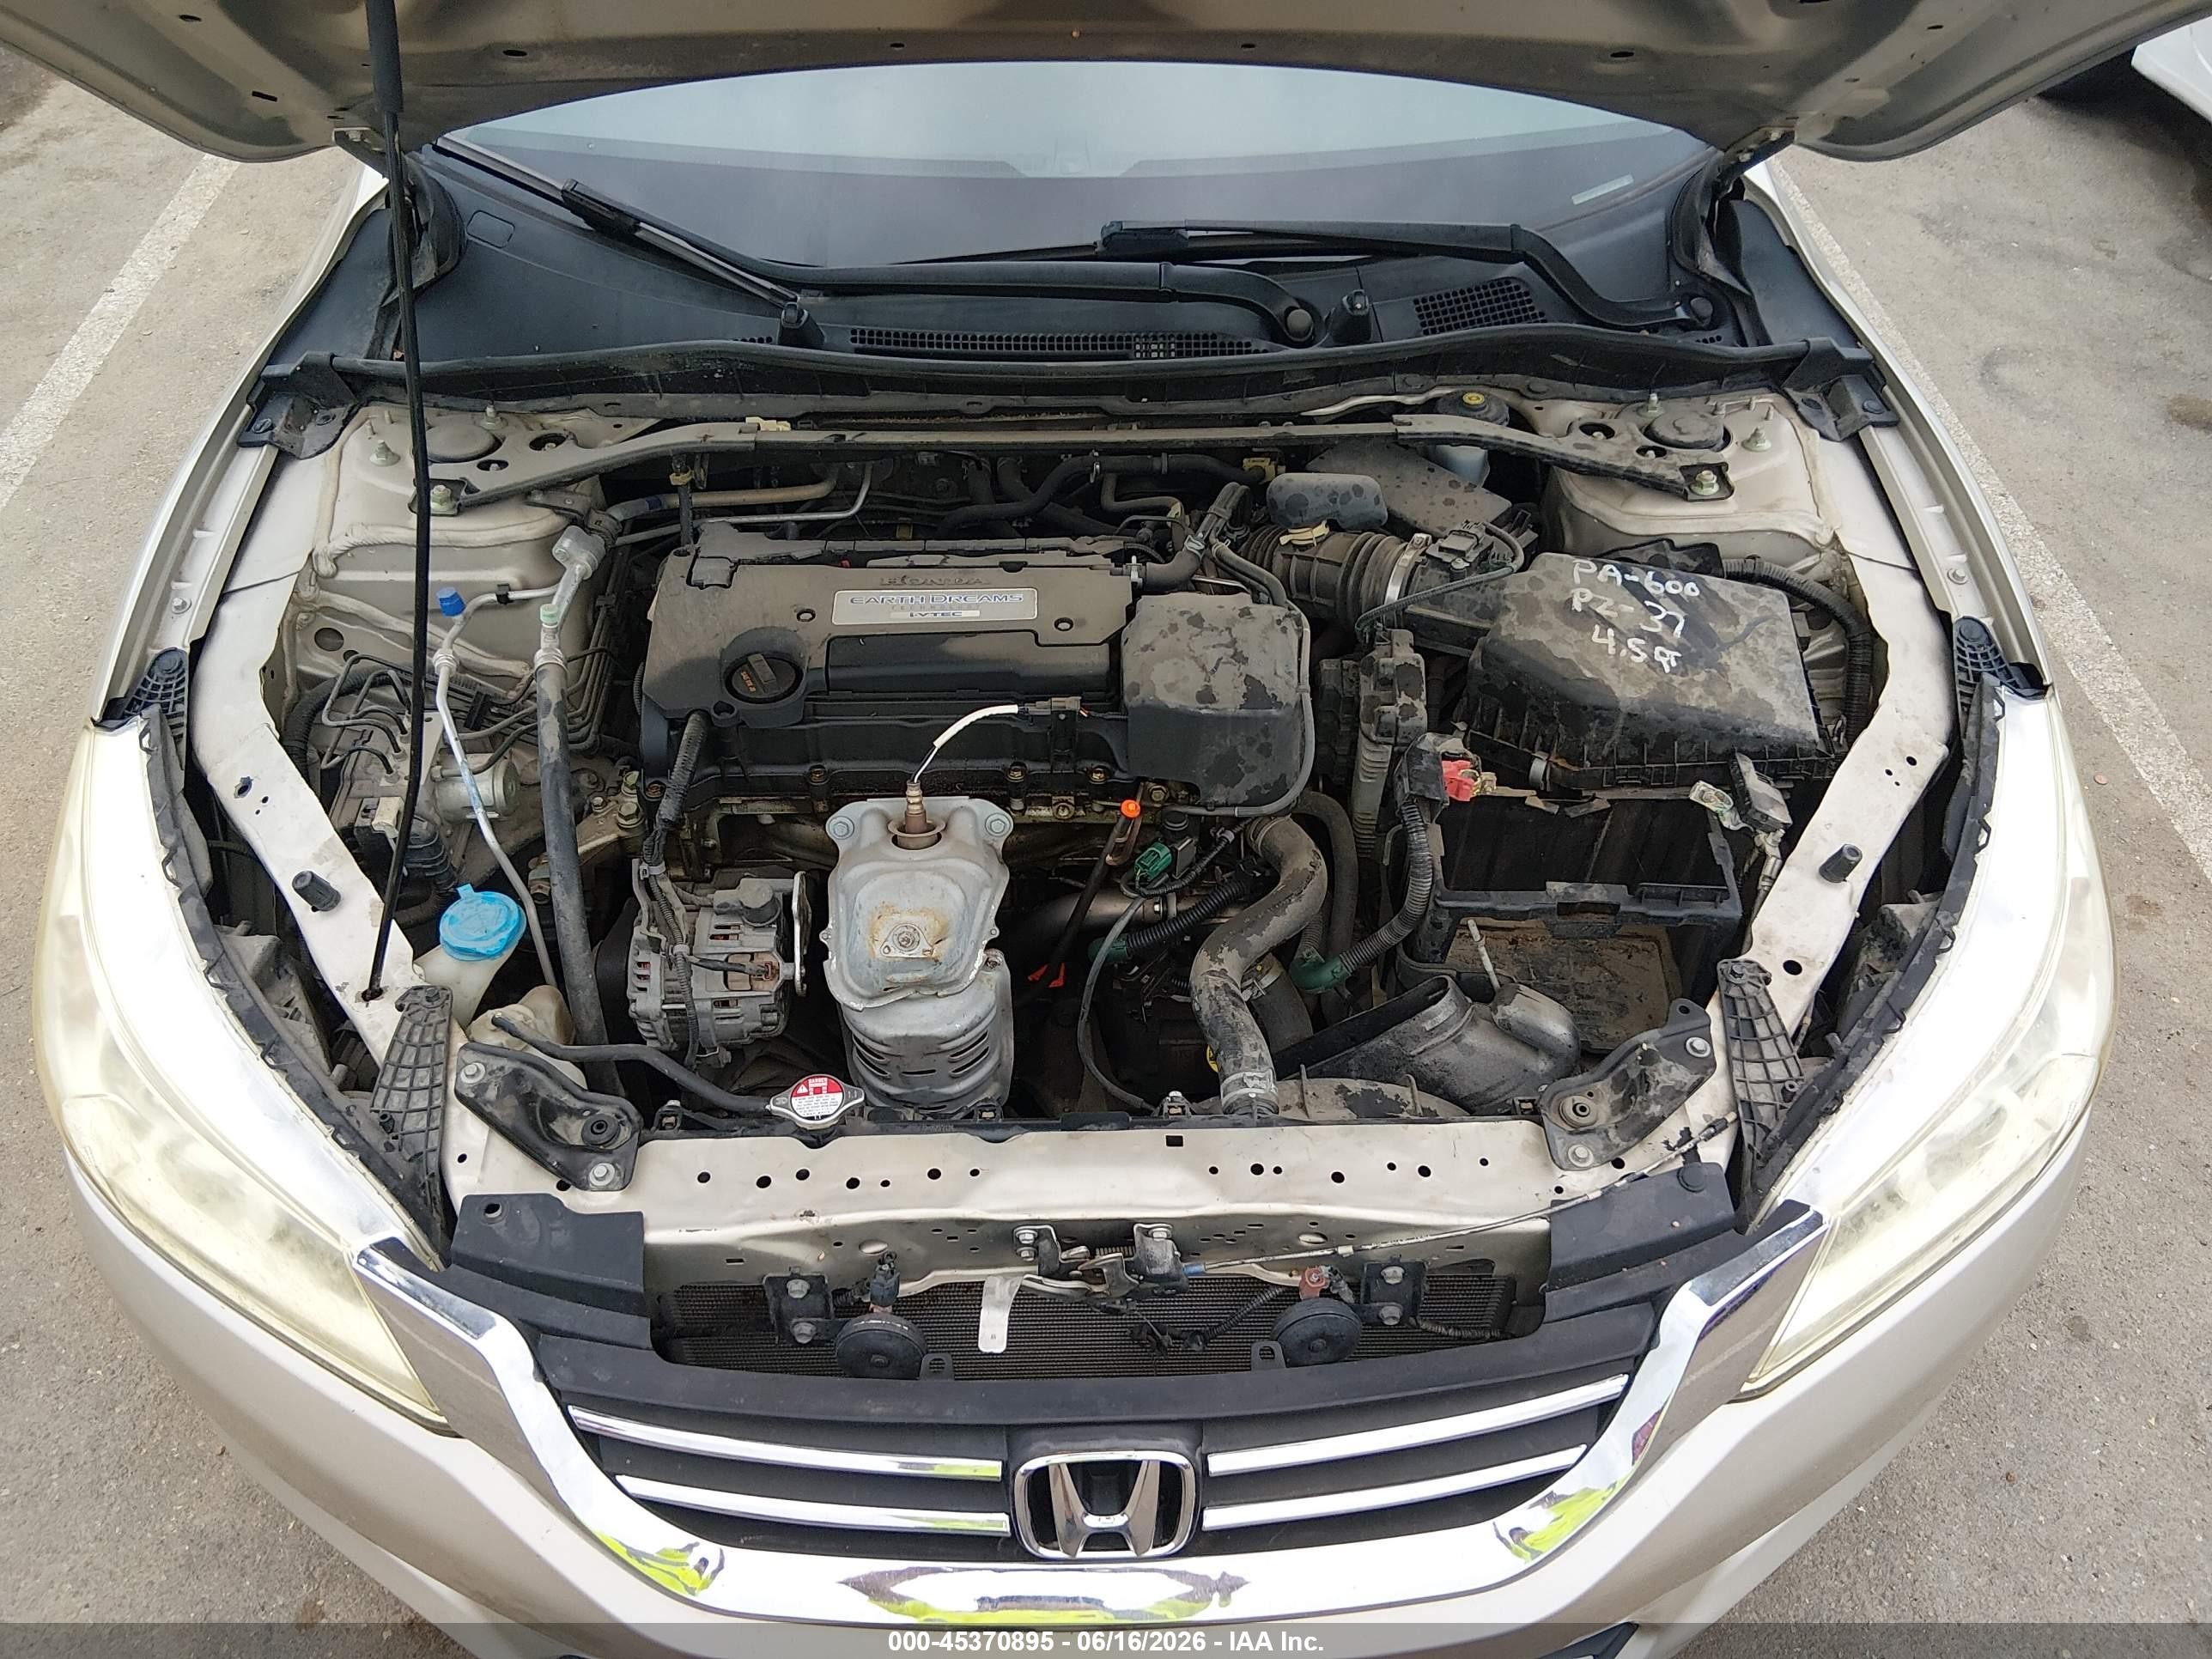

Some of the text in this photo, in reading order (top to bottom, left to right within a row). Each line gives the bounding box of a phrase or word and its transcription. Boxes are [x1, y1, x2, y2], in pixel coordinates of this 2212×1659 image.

[1572, 560, 1700, 597] PA-600
[849, 593, 1024, 605] EARTH DREAMS
